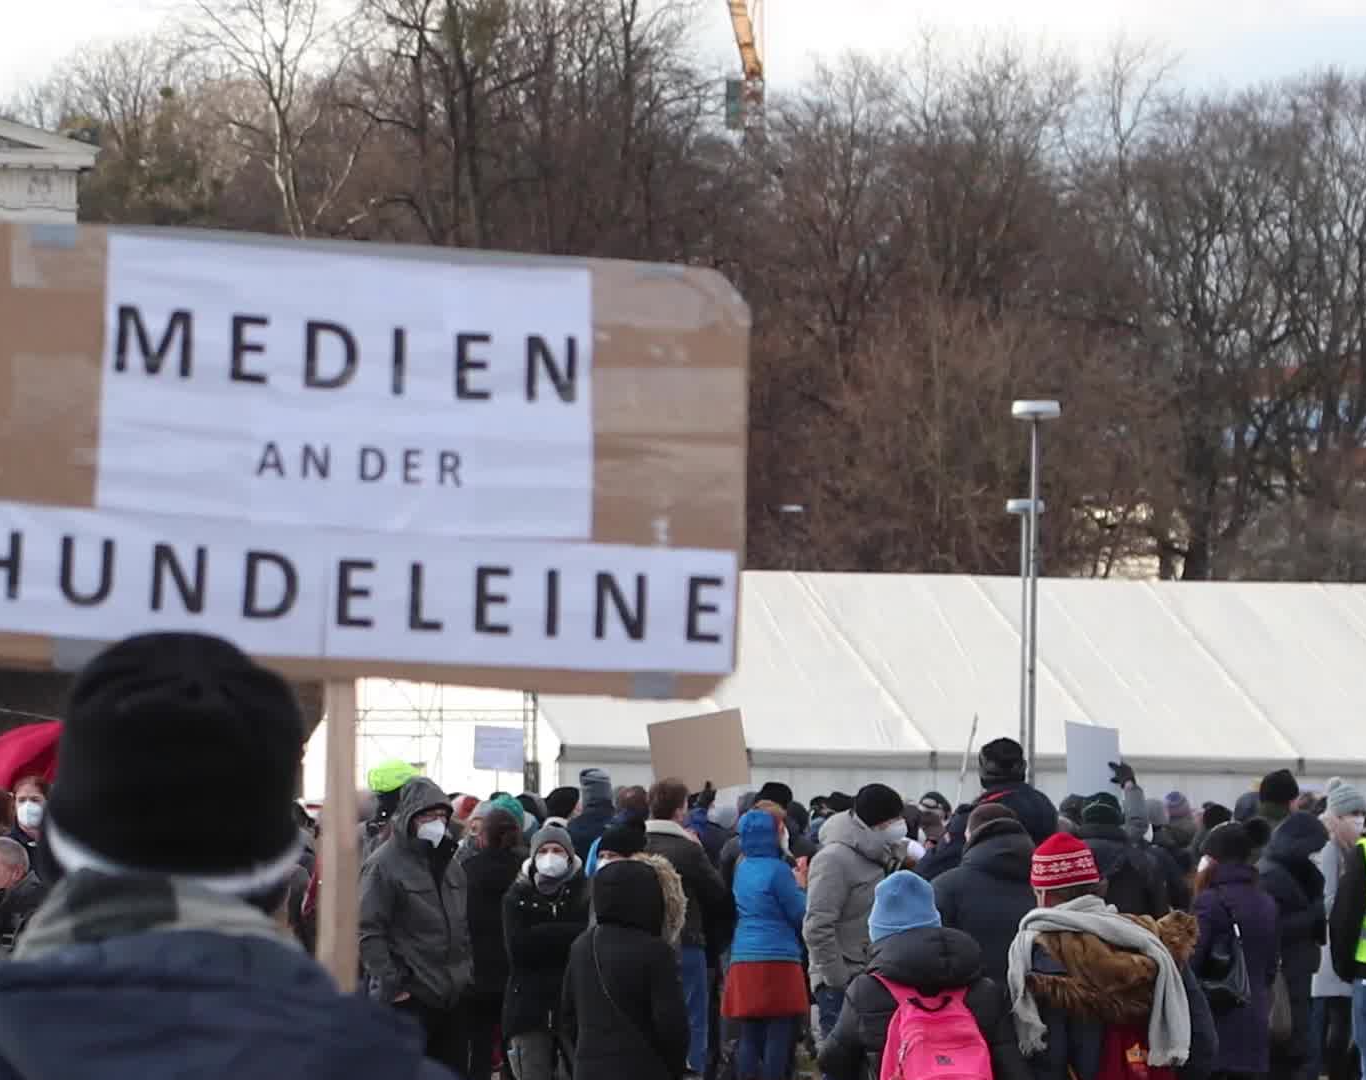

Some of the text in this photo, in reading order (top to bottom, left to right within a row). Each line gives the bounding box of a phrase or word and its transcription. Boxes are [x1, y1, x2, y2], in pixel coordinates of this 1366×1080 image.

[113, 304, 578, 403] MEDIEN
[256, 440, 464, 487] AN DER
